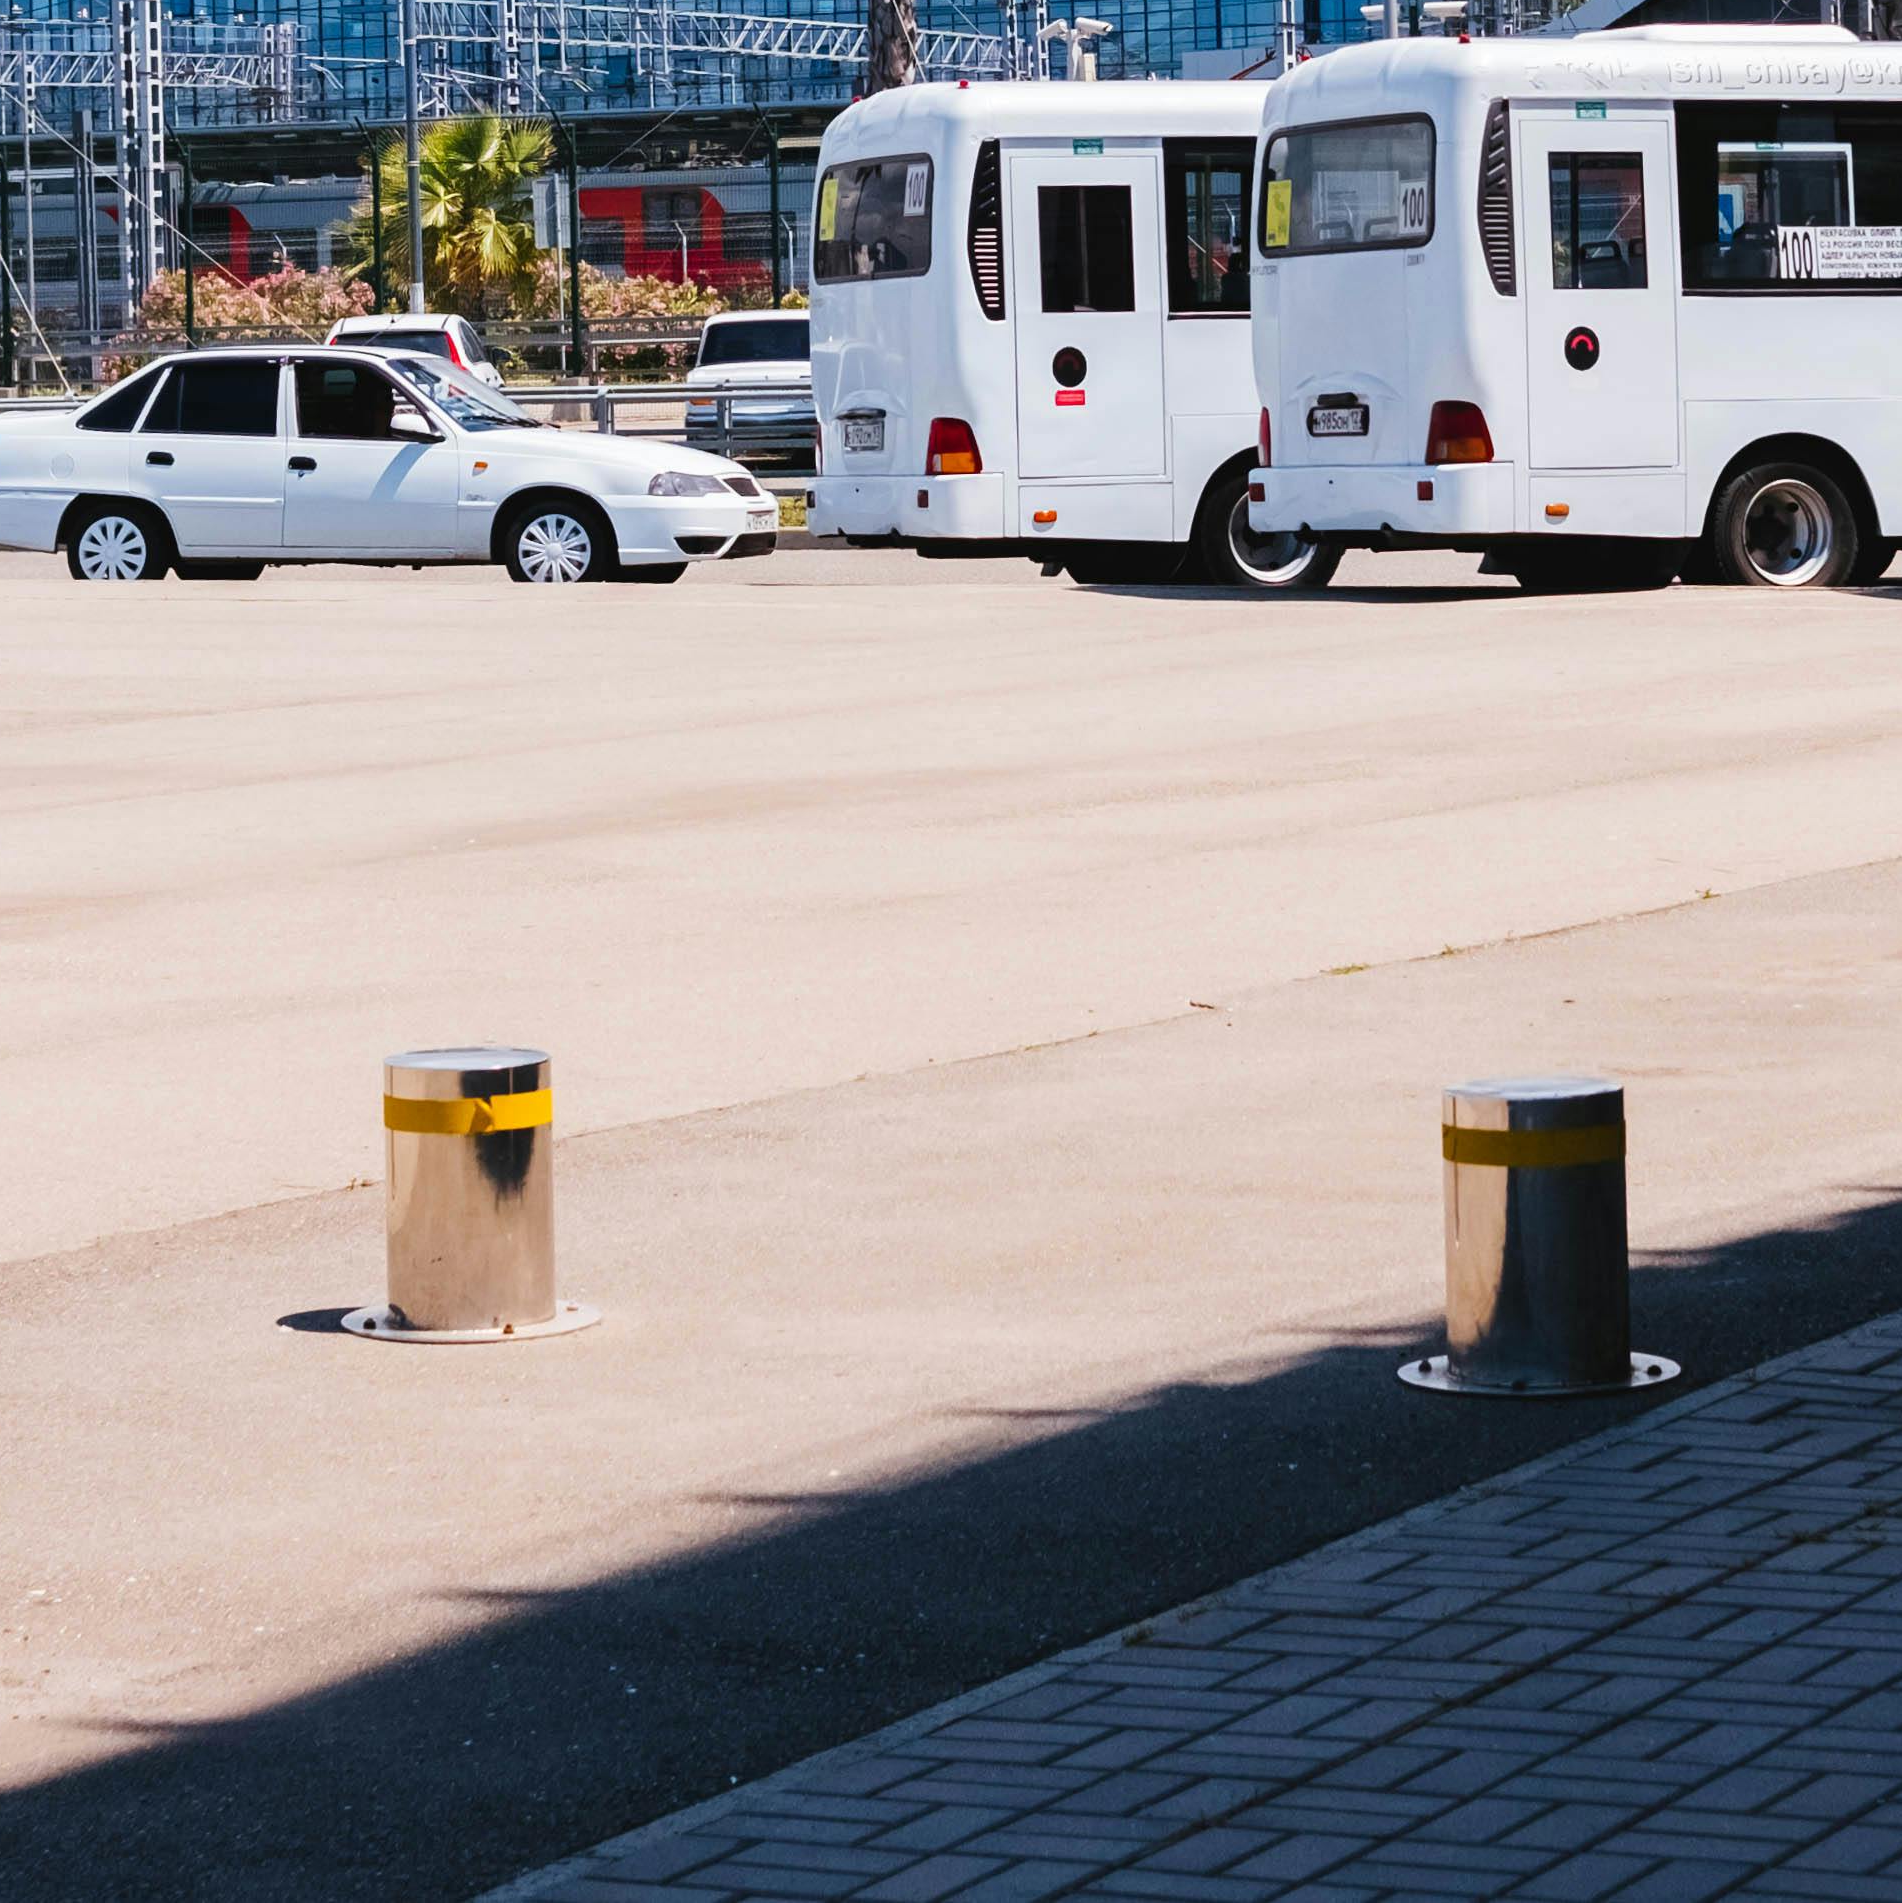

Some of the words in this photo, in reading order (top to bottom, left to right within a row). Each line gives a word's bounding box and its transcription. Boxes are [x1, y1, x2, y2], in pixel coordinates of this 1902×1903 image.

[909, 171, 925, 208] 100
[1402, 187, 1425, 228] 100
[1820, 228, 1866, 237] НЕКРАСОВКА
[1782, 231, 1813, 278] 100
[1821, 251, 1843, 260] АДЛЕР
[1833, 241, 1863, 249] РОССИЯ
